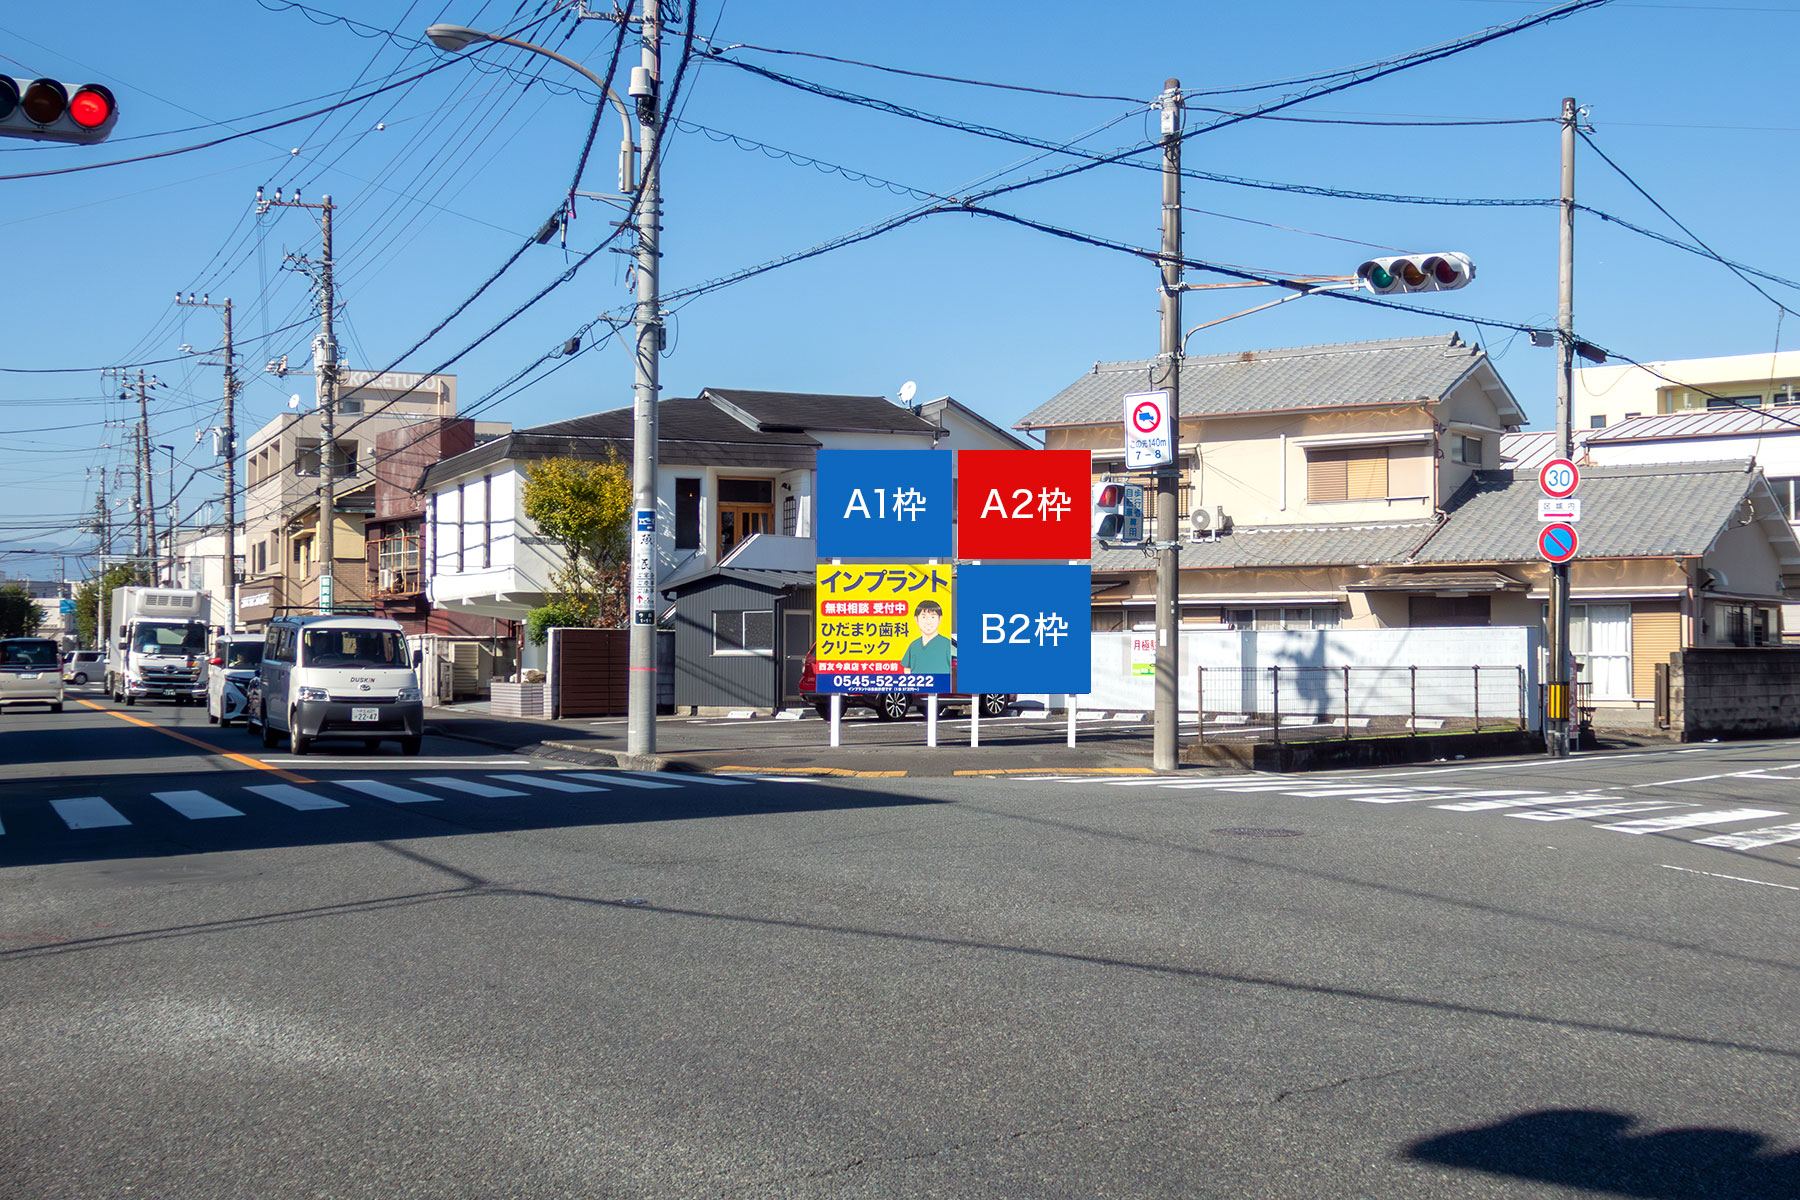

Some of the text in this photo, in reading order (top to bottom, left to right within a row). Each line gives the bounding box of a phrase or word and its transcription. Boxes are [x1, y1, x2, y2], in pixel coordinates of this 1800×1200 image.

[1130, 438, 1167, 449] この先140m
[1549, 470, 1570, 487] 30
[820, 569, 948, 593] インプラント
[825, 602, 906, 614] 無料相談 受付中
[821, 622, 909, 637] ひだまり歯科
[821, 640, 890, 655] クリニック
[819, 662, 835, 671] 西友
[861, 662, 898, 671] すぐ目の前
[833, 675, 934, 687] 0545-52-2222
